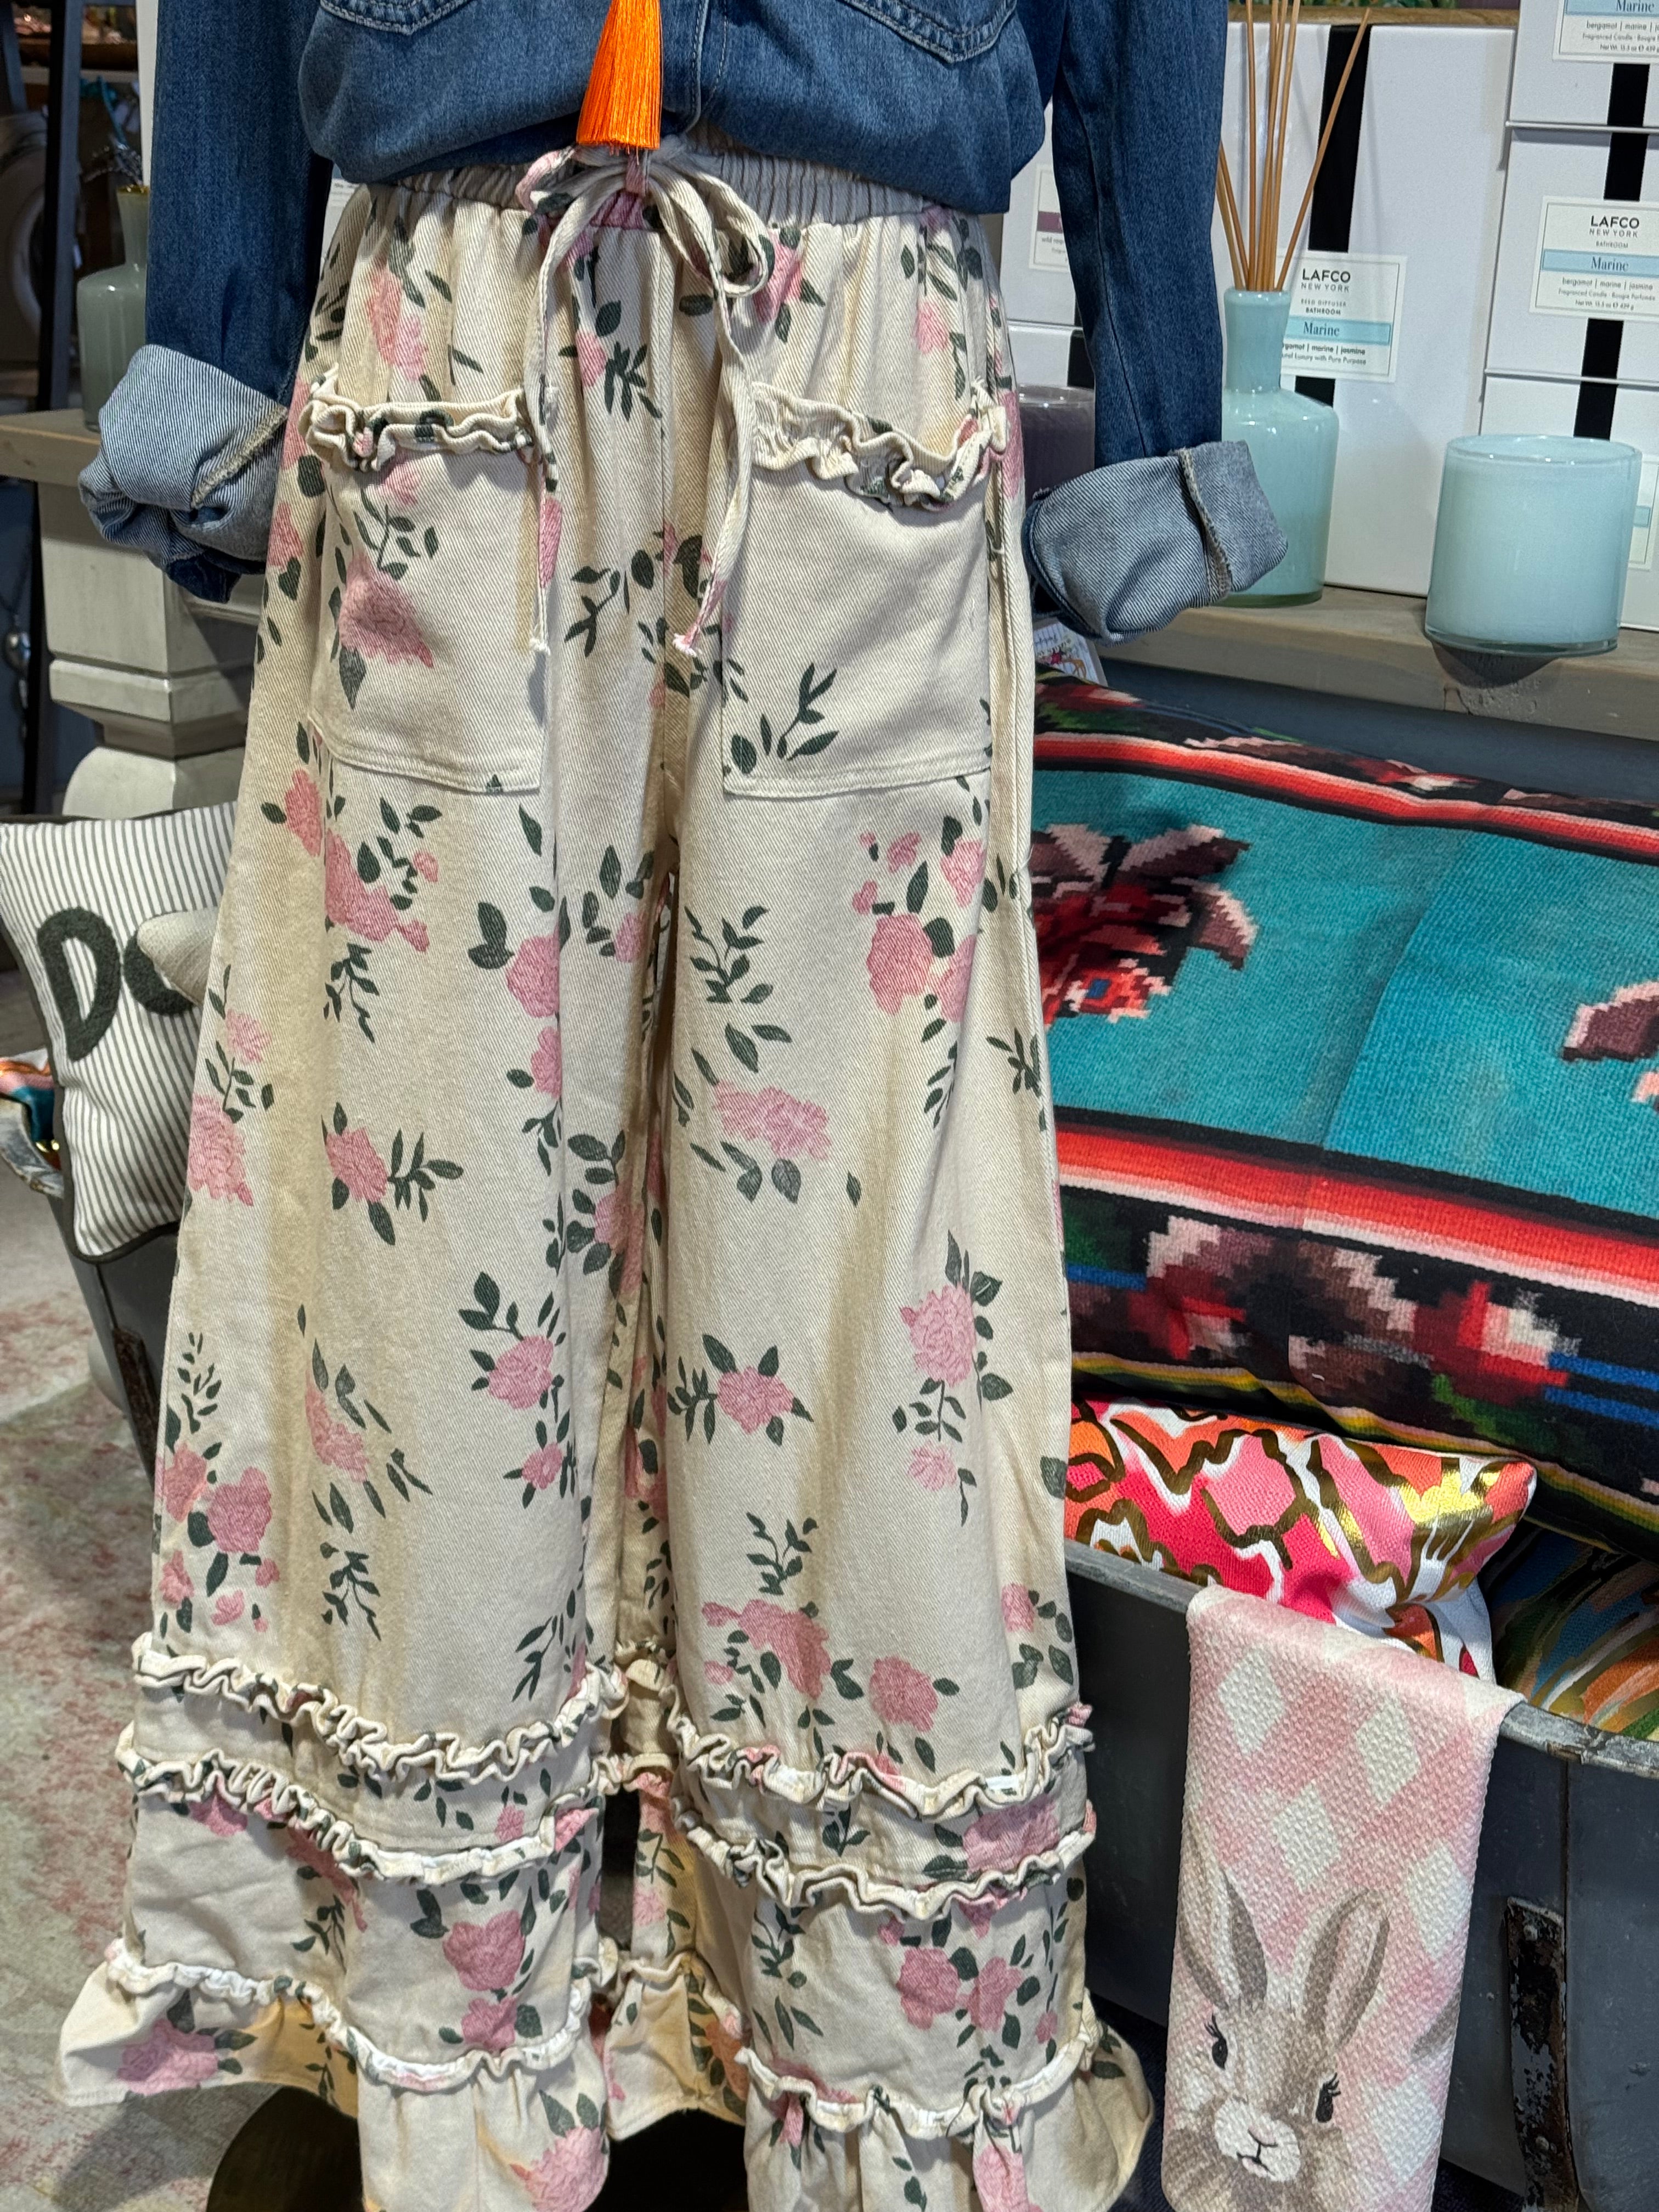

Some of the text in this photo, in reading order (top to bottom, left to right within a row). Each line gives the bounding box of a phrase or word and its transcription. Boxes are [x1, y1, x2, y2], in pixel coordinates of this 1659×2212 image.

[1616, 0, 1655, 13] Marine
[1586, 19, 1618, 31] bergamot
[1590, 215, 1640, 229] LAFCO
[1589, 228, 1638, 238] NEW YORK
[1595, 240, 1629, 249] BATHROOM
[1591, 256, 1629, 272] Marine
[1302, 268, 1351, 283] LAFCO
[1301, 282, 1350, 293] NEW YORK
[1562, 276, 1653, 291] bergamot marine jasmine
[1318, 298, 1347, 307] DIFFUSER
[1305, 307, 1341, 315] BATHROOM
[1303, 321, 1340, 337] Marine
[1311, 345, 1334, 353] marine
[1340, 346, 1365, 356] jasmine
